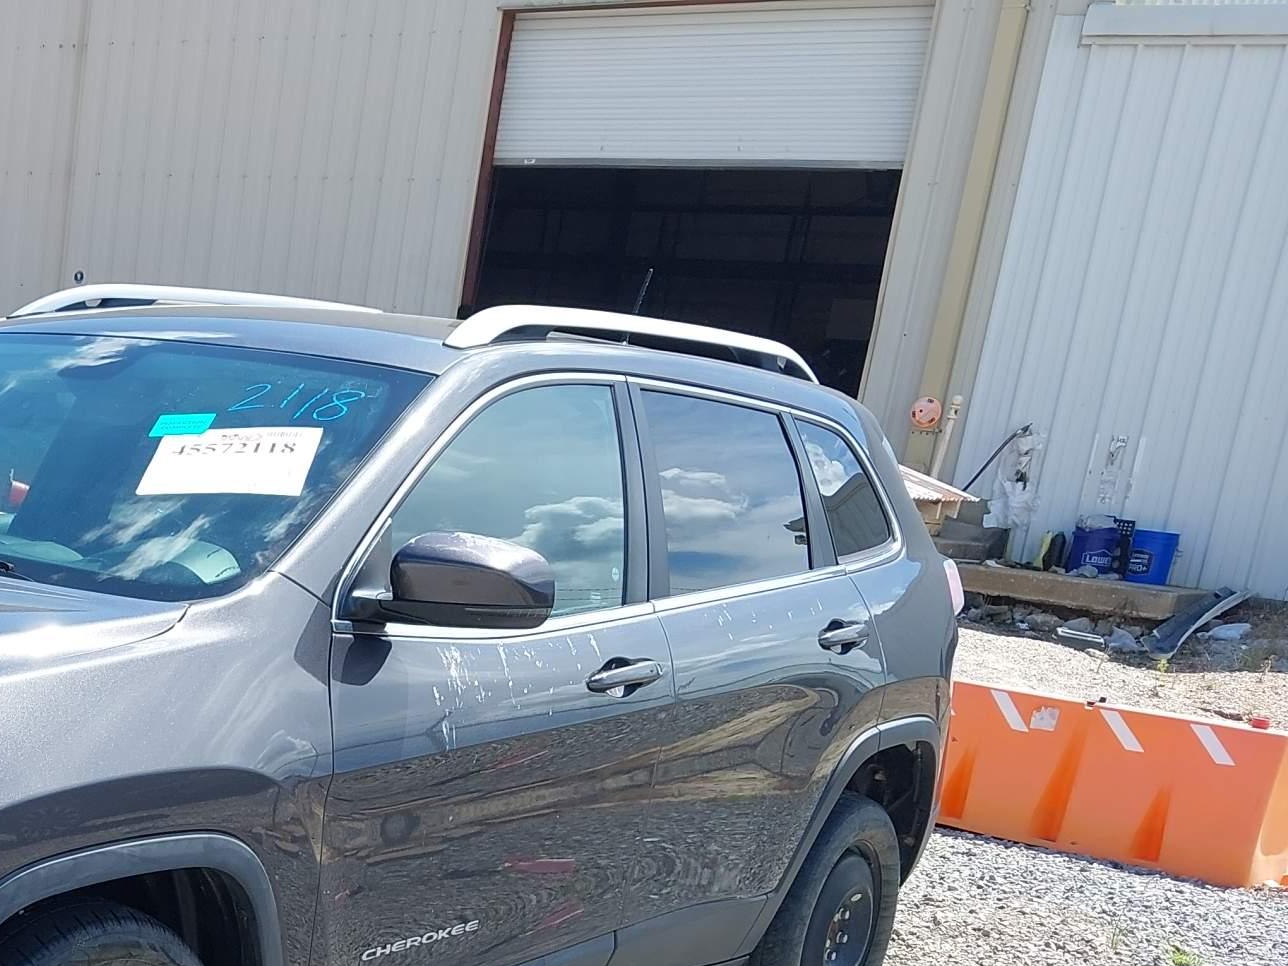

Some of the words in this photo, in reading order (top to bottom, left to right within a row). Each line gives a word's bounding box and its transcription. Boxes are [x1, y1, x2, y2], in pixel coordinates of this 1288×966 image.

[227, 383, 366, 421] 2118
[172, 441, 297, 456] 45572118
[361, 920, 479, 961] CHEROKEE
